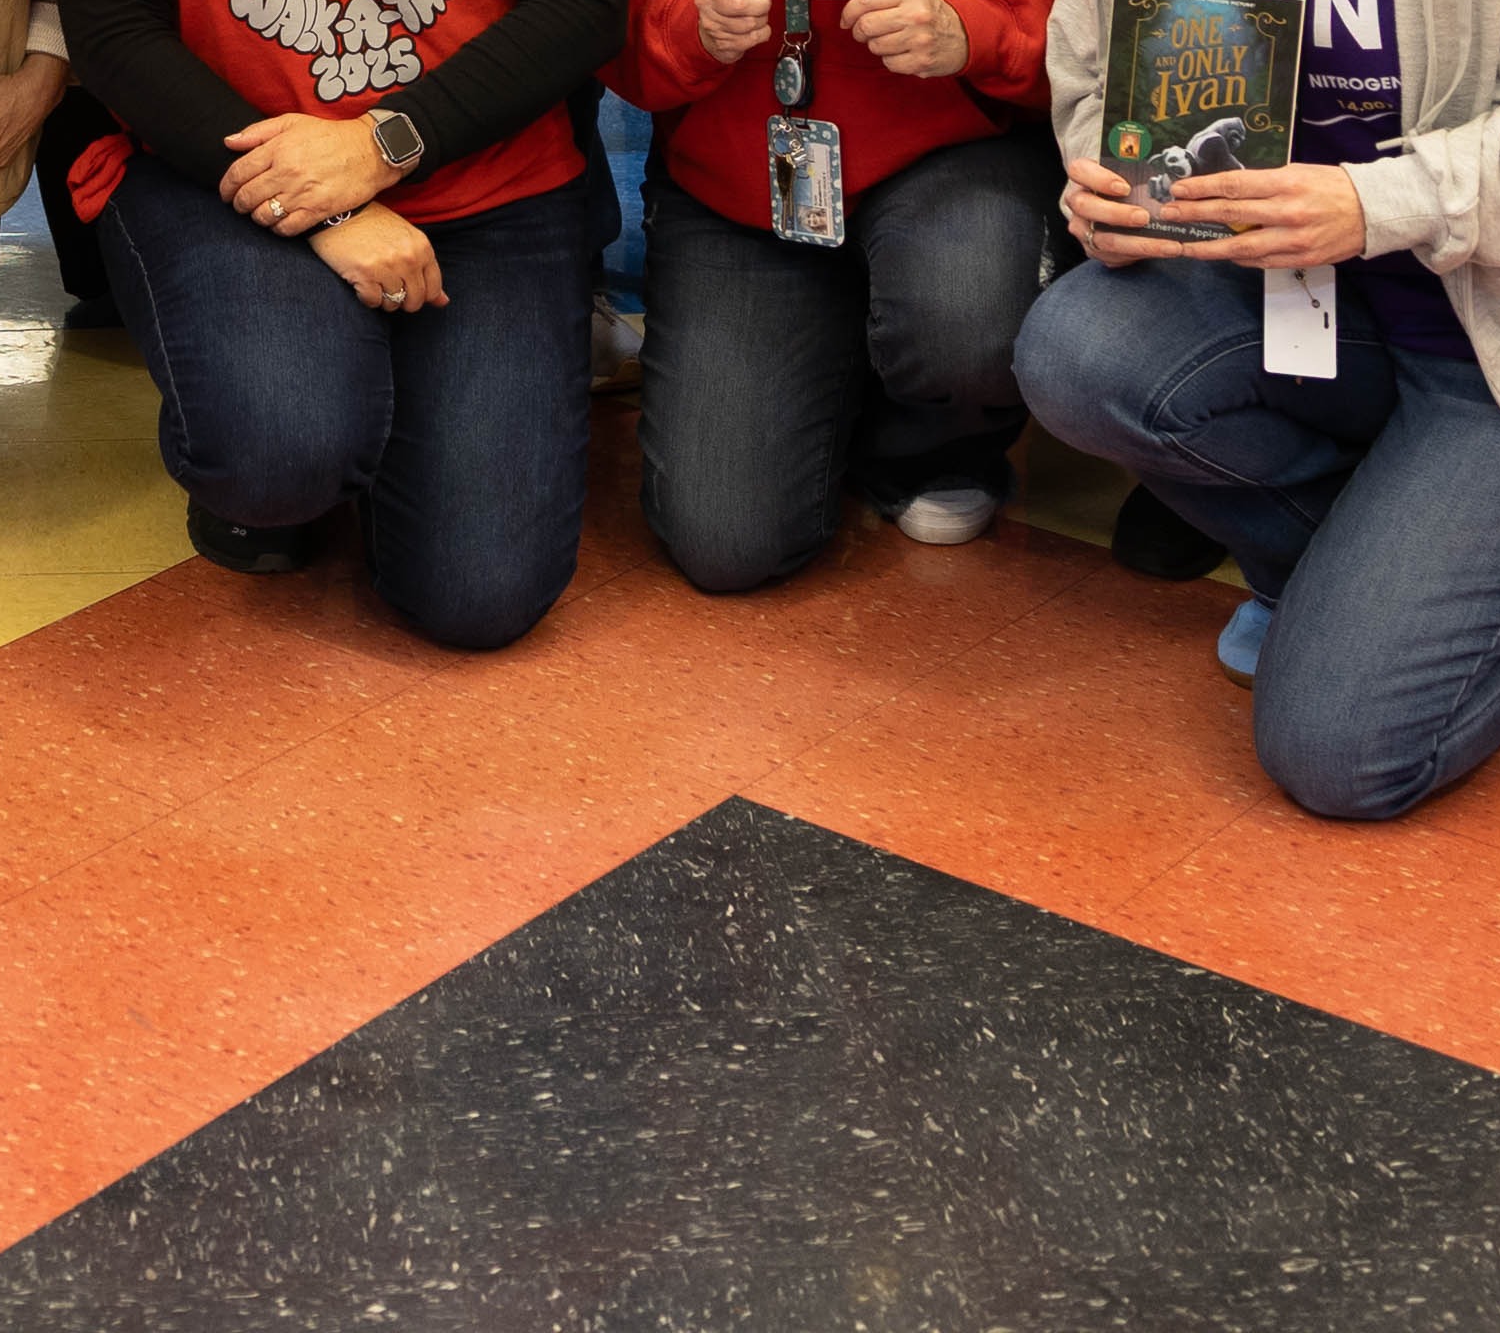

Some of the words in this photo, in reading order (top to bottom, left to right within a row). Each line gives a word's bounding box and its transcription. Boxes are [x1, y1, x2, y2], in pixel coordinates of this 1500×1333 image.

[1171, 15, 1224, 49] ONE
[311, 37, 421, 102] 2025
[1177, 45, 1248, 81] ONLY
[1151, 71, 1247, 122] Ivan
